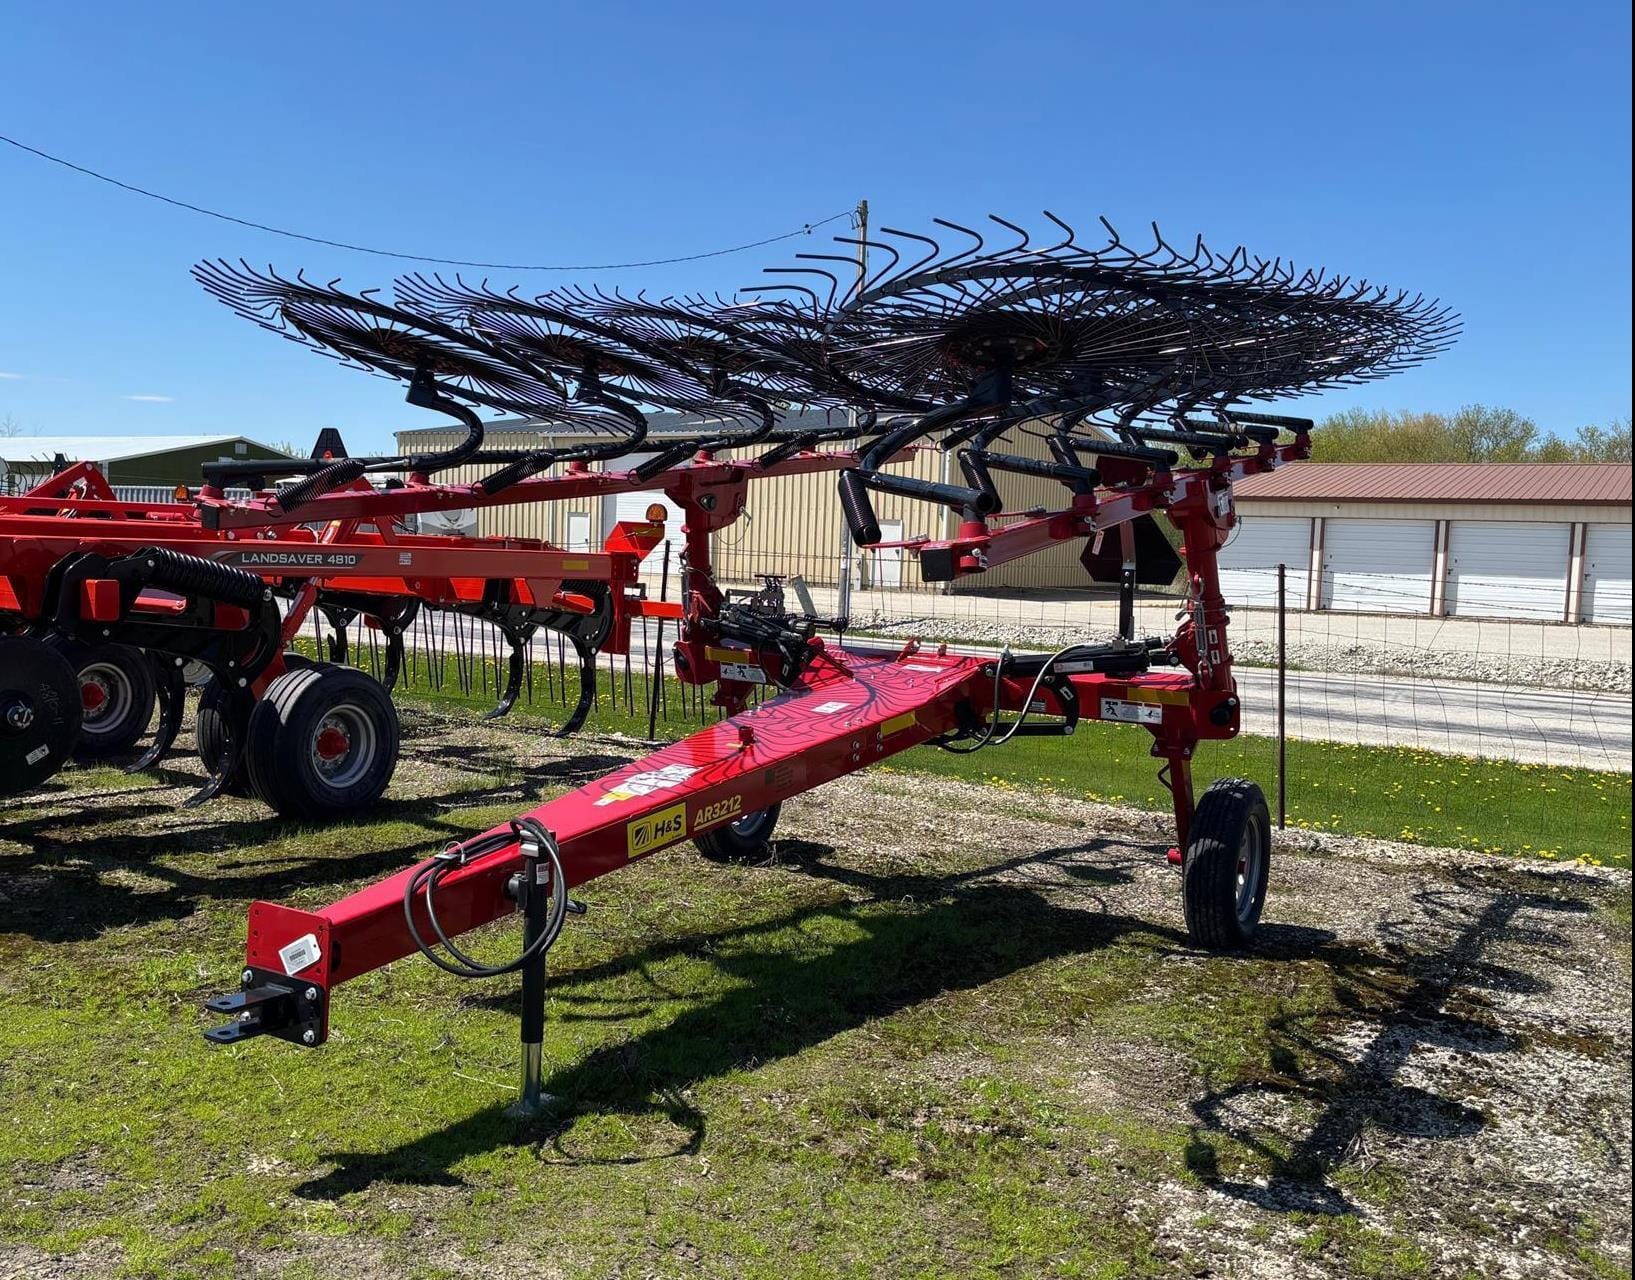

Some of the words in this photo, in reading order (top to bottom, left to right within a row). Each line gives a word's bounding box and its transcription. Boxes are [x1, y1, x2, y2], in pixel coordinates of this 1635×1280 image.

[241, 553, 323, 565] LANDSAVER
[327, 554, 356, 565] 4810
[693, 795, 742, 827] AR3212
[653, 814, 682, 841] H&S
